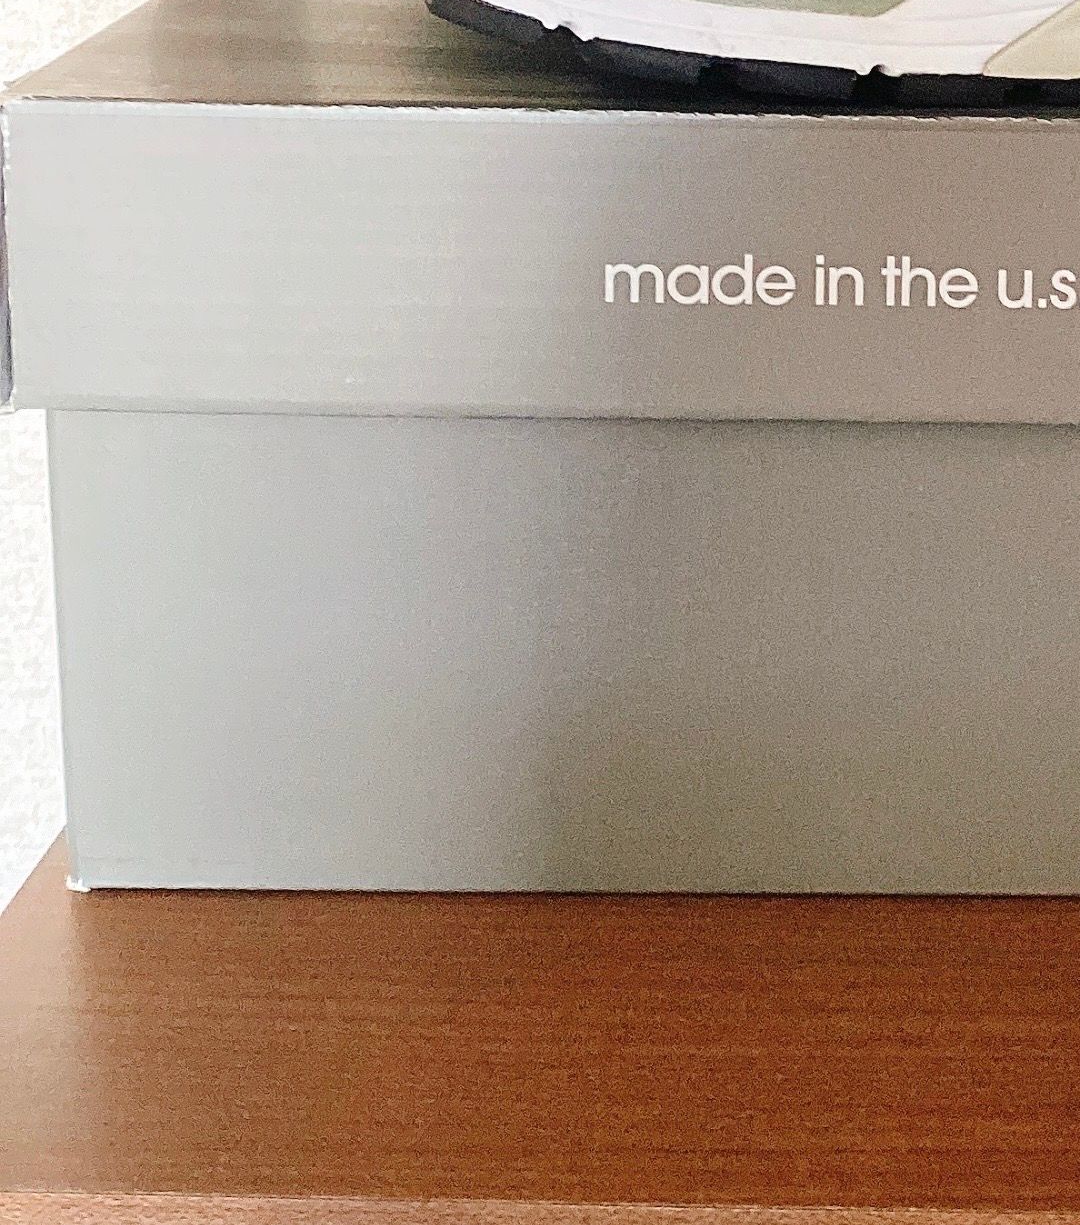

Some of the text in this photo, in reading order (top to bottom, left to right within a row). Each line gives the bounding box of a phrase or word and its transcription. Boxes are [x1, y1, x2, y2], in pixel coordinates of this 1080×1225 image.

[605, 254, 796, 306] made
[816, 255, 864, 307] in
[881, 256, 978, 309] the
